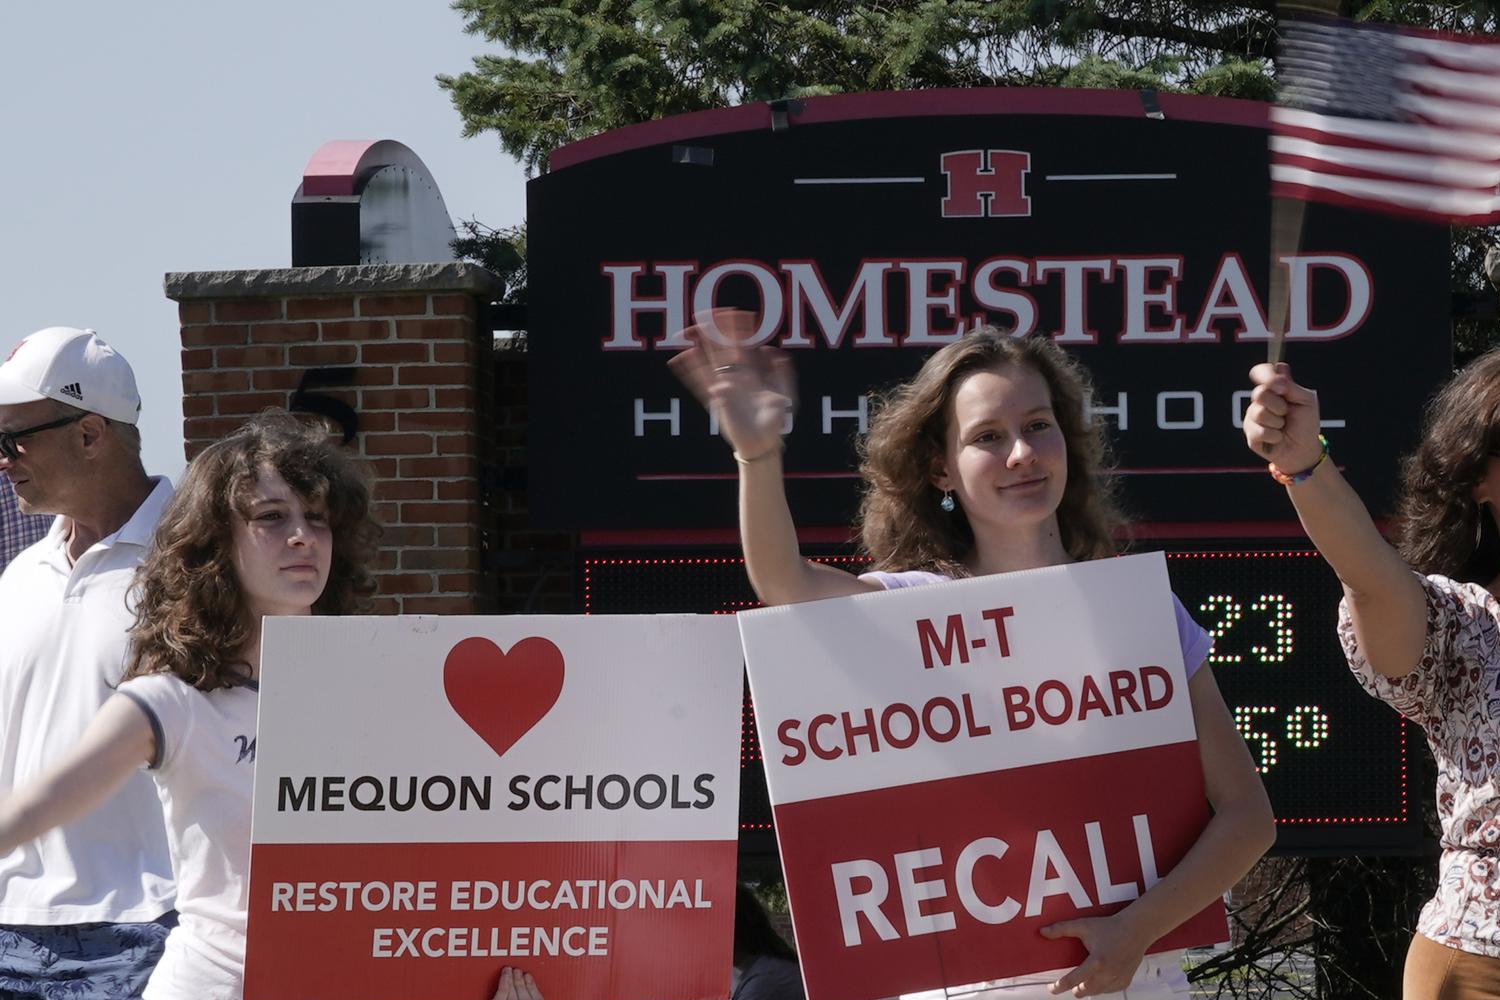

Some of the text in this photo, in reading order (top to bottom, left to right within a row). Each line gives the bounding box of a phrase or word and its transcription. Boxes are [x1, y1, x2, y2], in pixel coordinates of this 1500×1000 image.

[939, 148, 1032, 218] H
[602, 253, 1374, 351] HOMESTEAD
[916, 607, 1015, 670] M-T
[777, 665, 1174, 766] SCHOOL BOARD
[277, 773, 716, 812] MEQUON SCHOOLS
[271, 878, 712, 912] RESTORE EDUCATIONAL
[372, 926, 609, 958] EXCELLENCE
